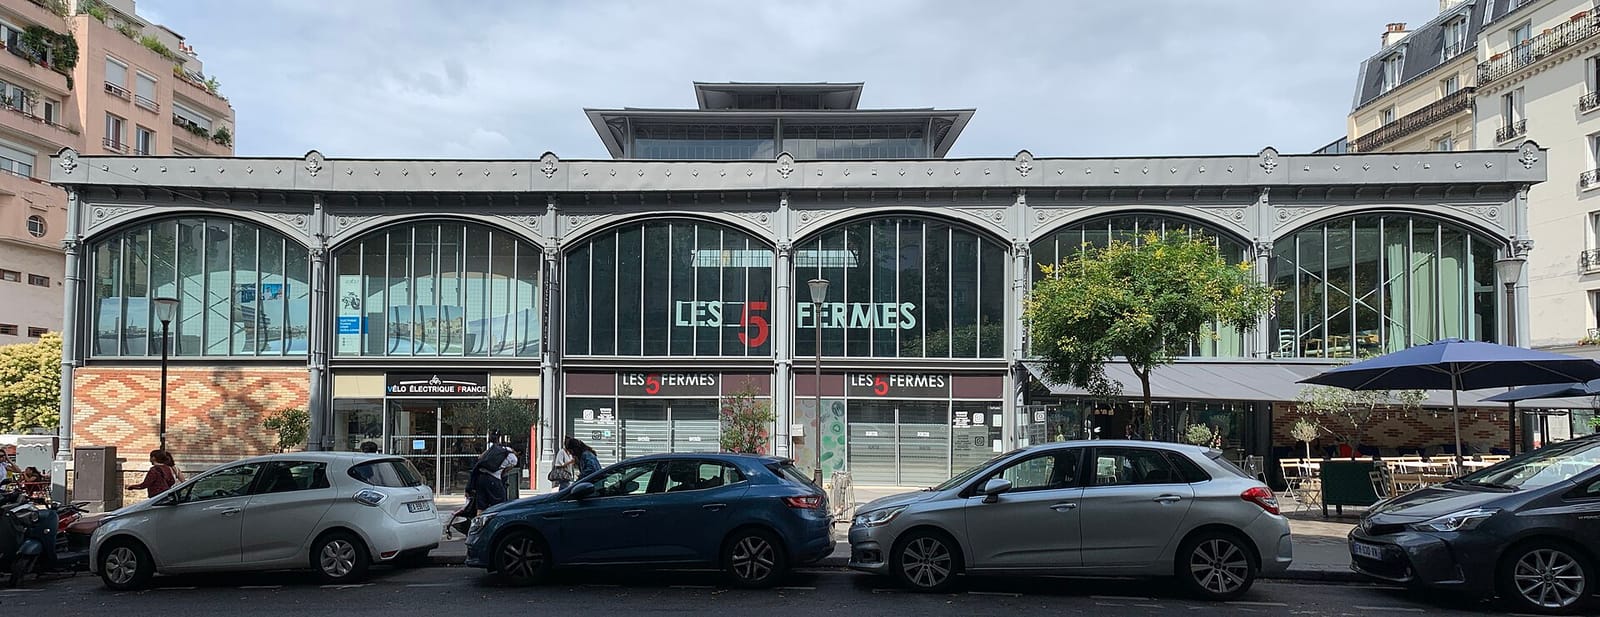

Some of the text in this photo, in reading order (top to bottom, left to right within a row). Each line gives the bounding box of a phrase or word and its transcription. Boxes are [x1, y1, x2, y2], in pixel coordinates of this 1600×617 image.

[676, 301, 916, 348] LES 5 FERMES
[387, 385, 486, 393] VÉLO ÉLECTRIQUE FRANCE
[622, 373, 715, 394] LES 5 FERMES
[851, 374, 945, 395] LES 5 FERMES
